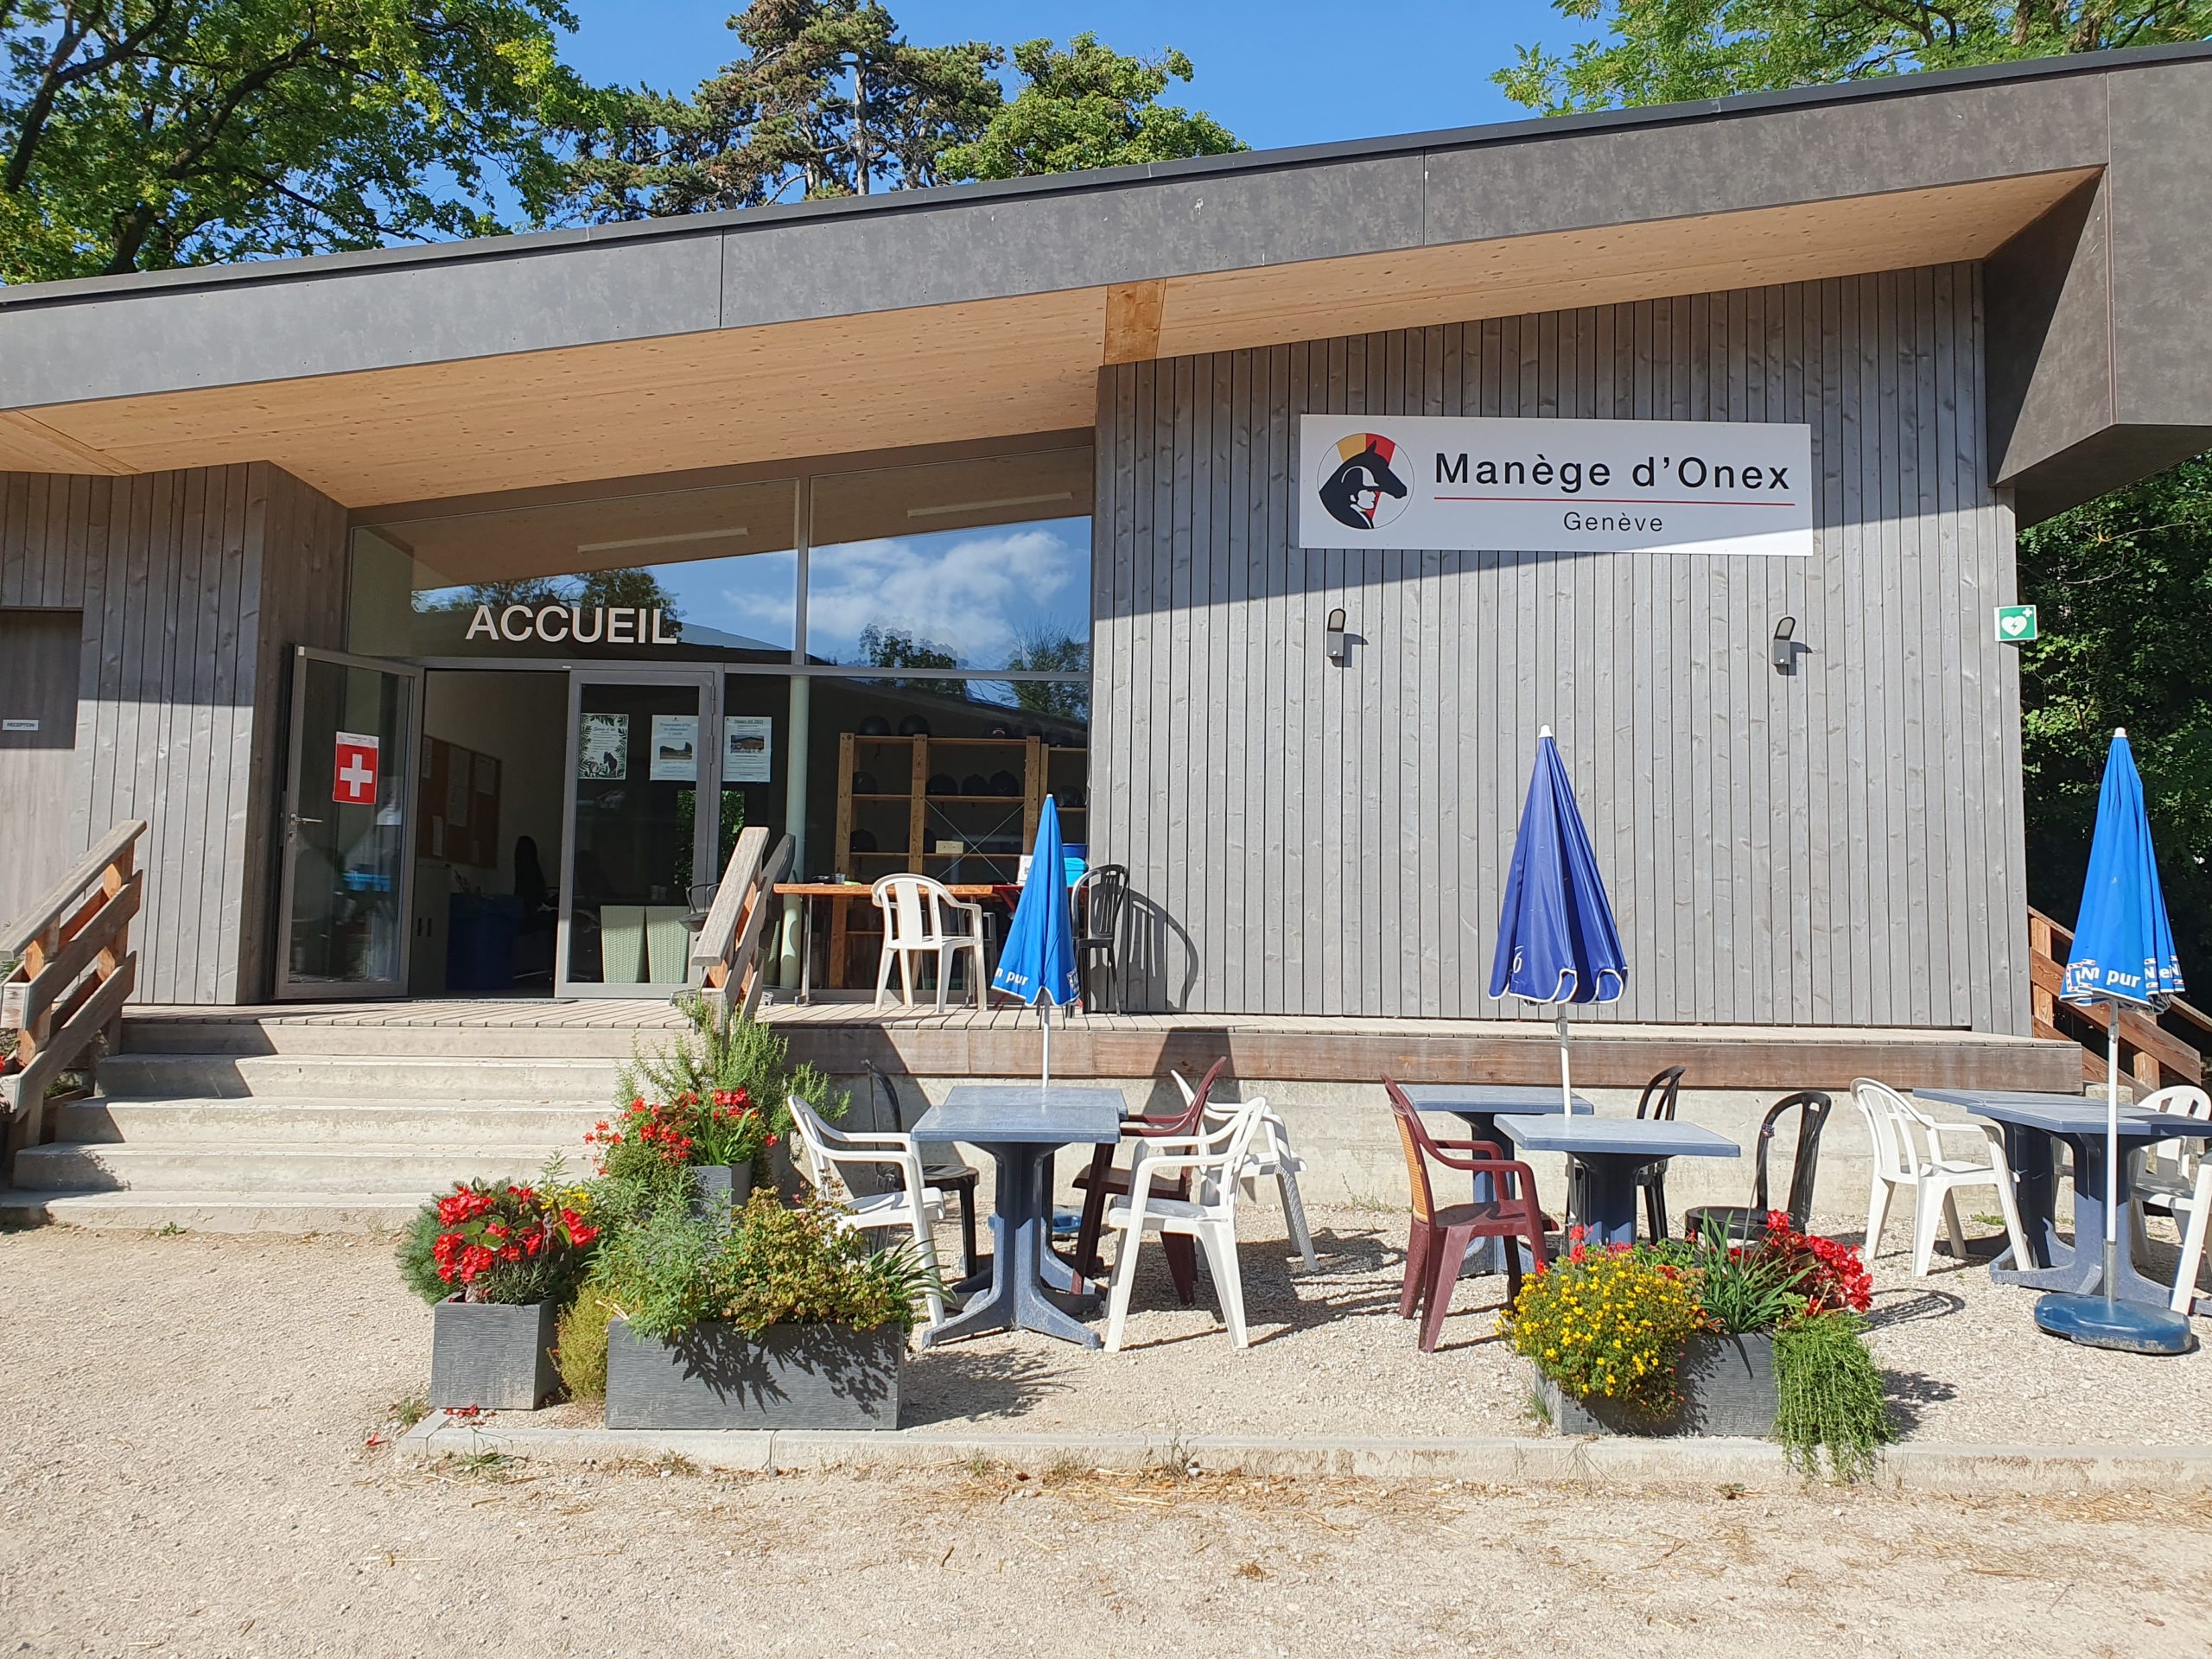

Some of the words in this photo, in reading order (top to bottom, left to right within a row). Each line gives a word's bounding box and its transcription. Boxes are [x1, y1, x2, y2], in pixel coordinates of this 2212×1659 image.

[1435, 452, 1611, 493] Manège
[1632, 455, 1790, 490] d'Onex
[1563, 512, 1663, 532] Genève
[465, 605, 677, 645] ACCUEIL
[1006, 971, 1029, 987] pur
[2106, 969, 2141, 988] pur
